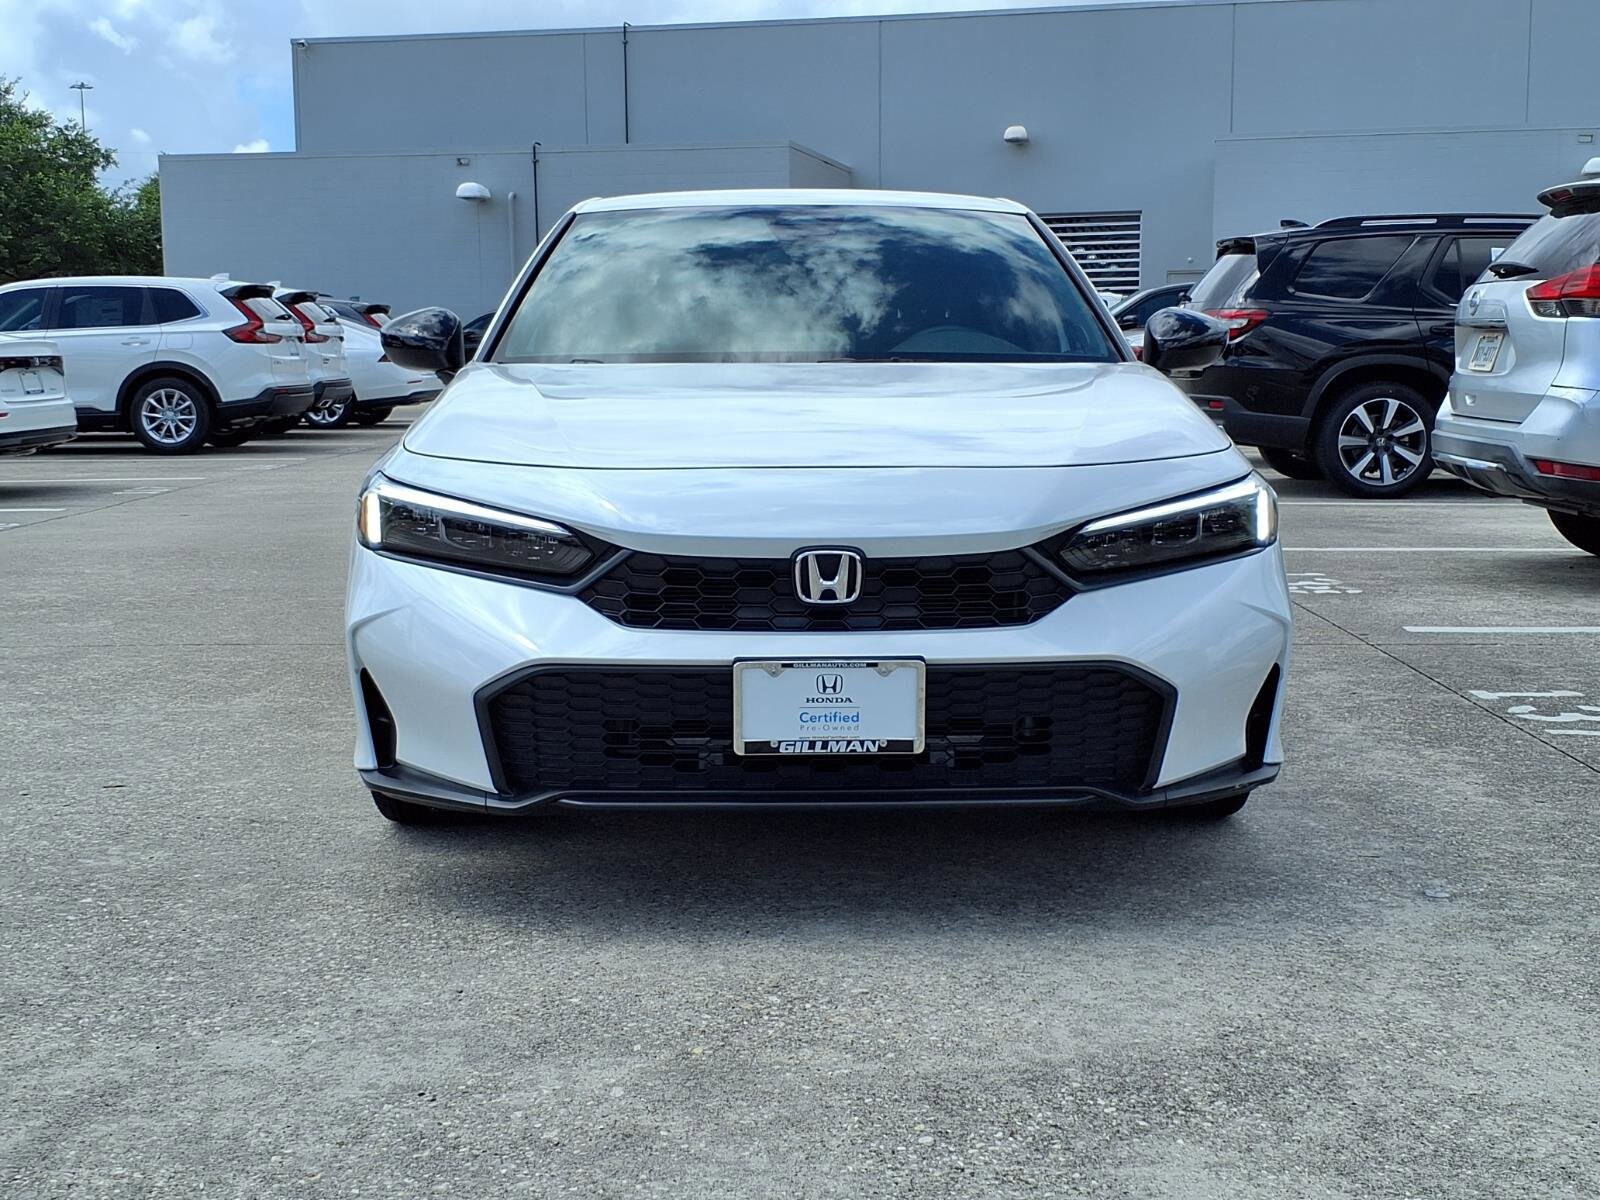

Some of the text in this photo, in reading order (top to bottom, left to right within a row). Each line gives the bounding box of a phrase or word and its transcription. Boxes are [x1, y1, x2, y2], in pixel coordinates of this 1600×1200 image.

[799, 711, 860, 723] Certified
[800, 724, 860, 732] Pre-Owned
[779, 740, 879, 753] GILLMAN
